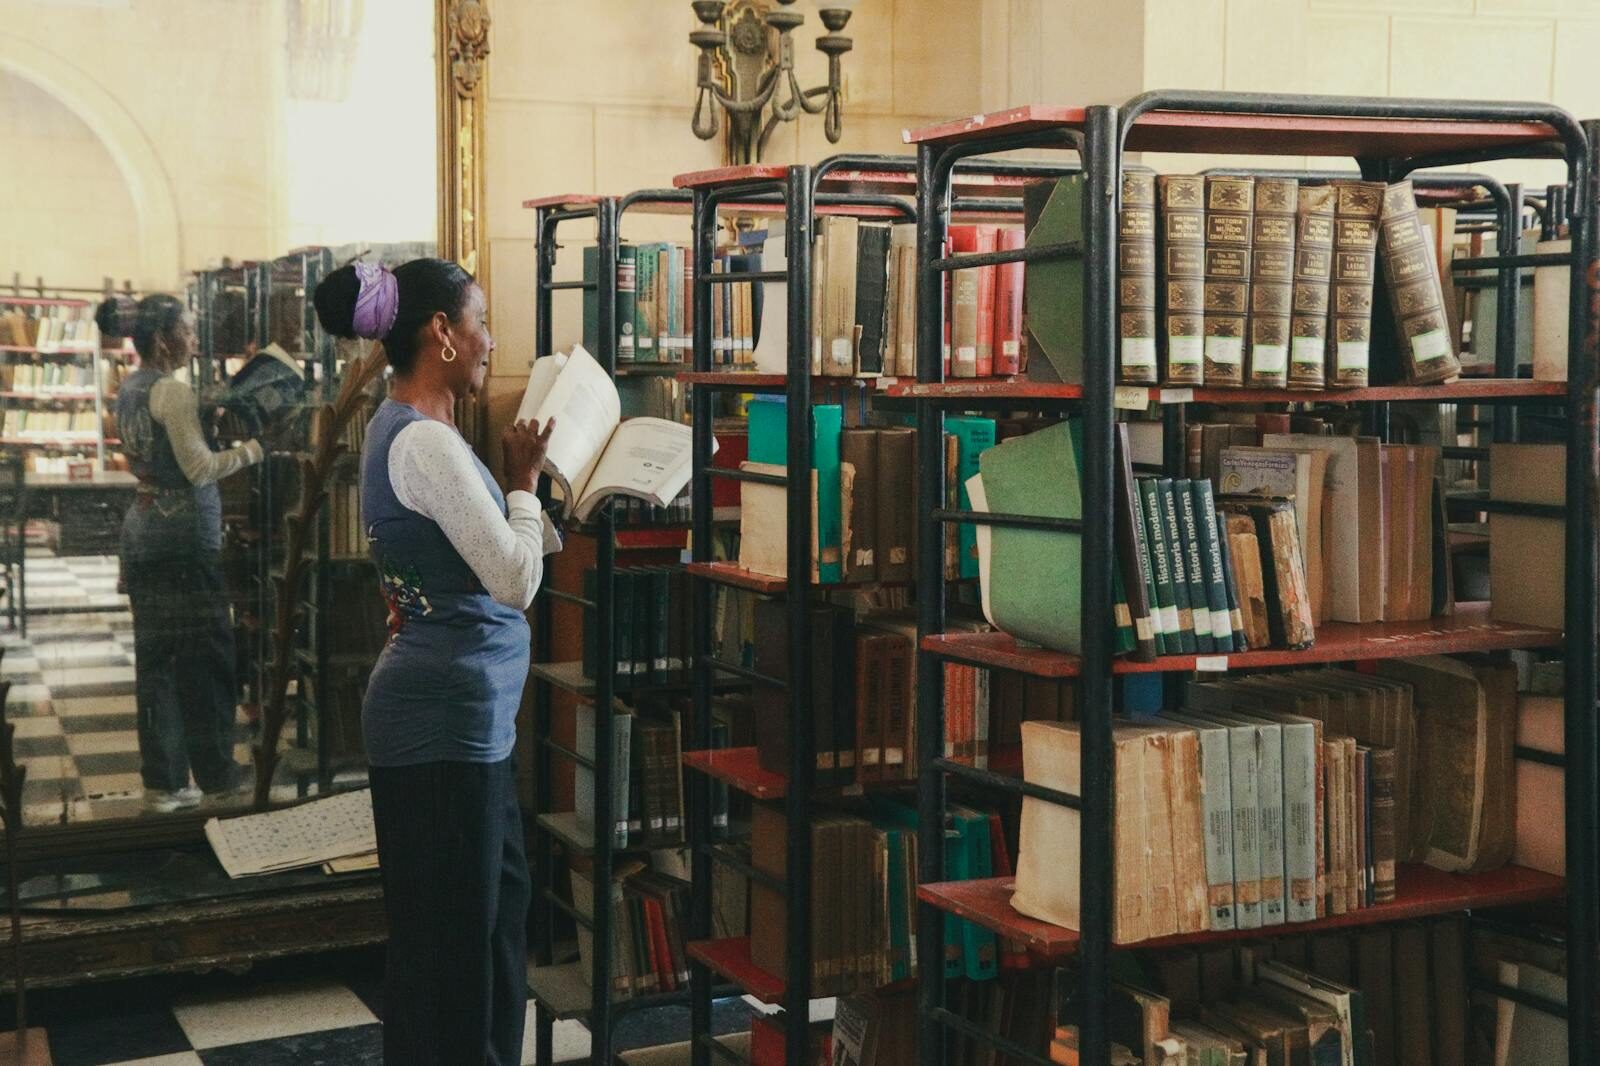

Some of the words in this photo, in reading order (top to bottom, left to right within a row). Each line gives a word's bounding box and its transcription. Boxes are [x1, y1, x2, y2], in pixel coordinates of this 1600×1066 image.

[1147, 492, 1162, 540] moderna
[1165, 491, 1179, 539] moderna
[1181, 491, 1195, 539] moderna
[1203, 491, 1217, 539] moderna
[1154, 543, 1169, 585] Historia
[1171, 542, 1185, 583] Historia
[1188, 541, 1202, 584] Historia
[1209, 541, 1223, 584] Historia
